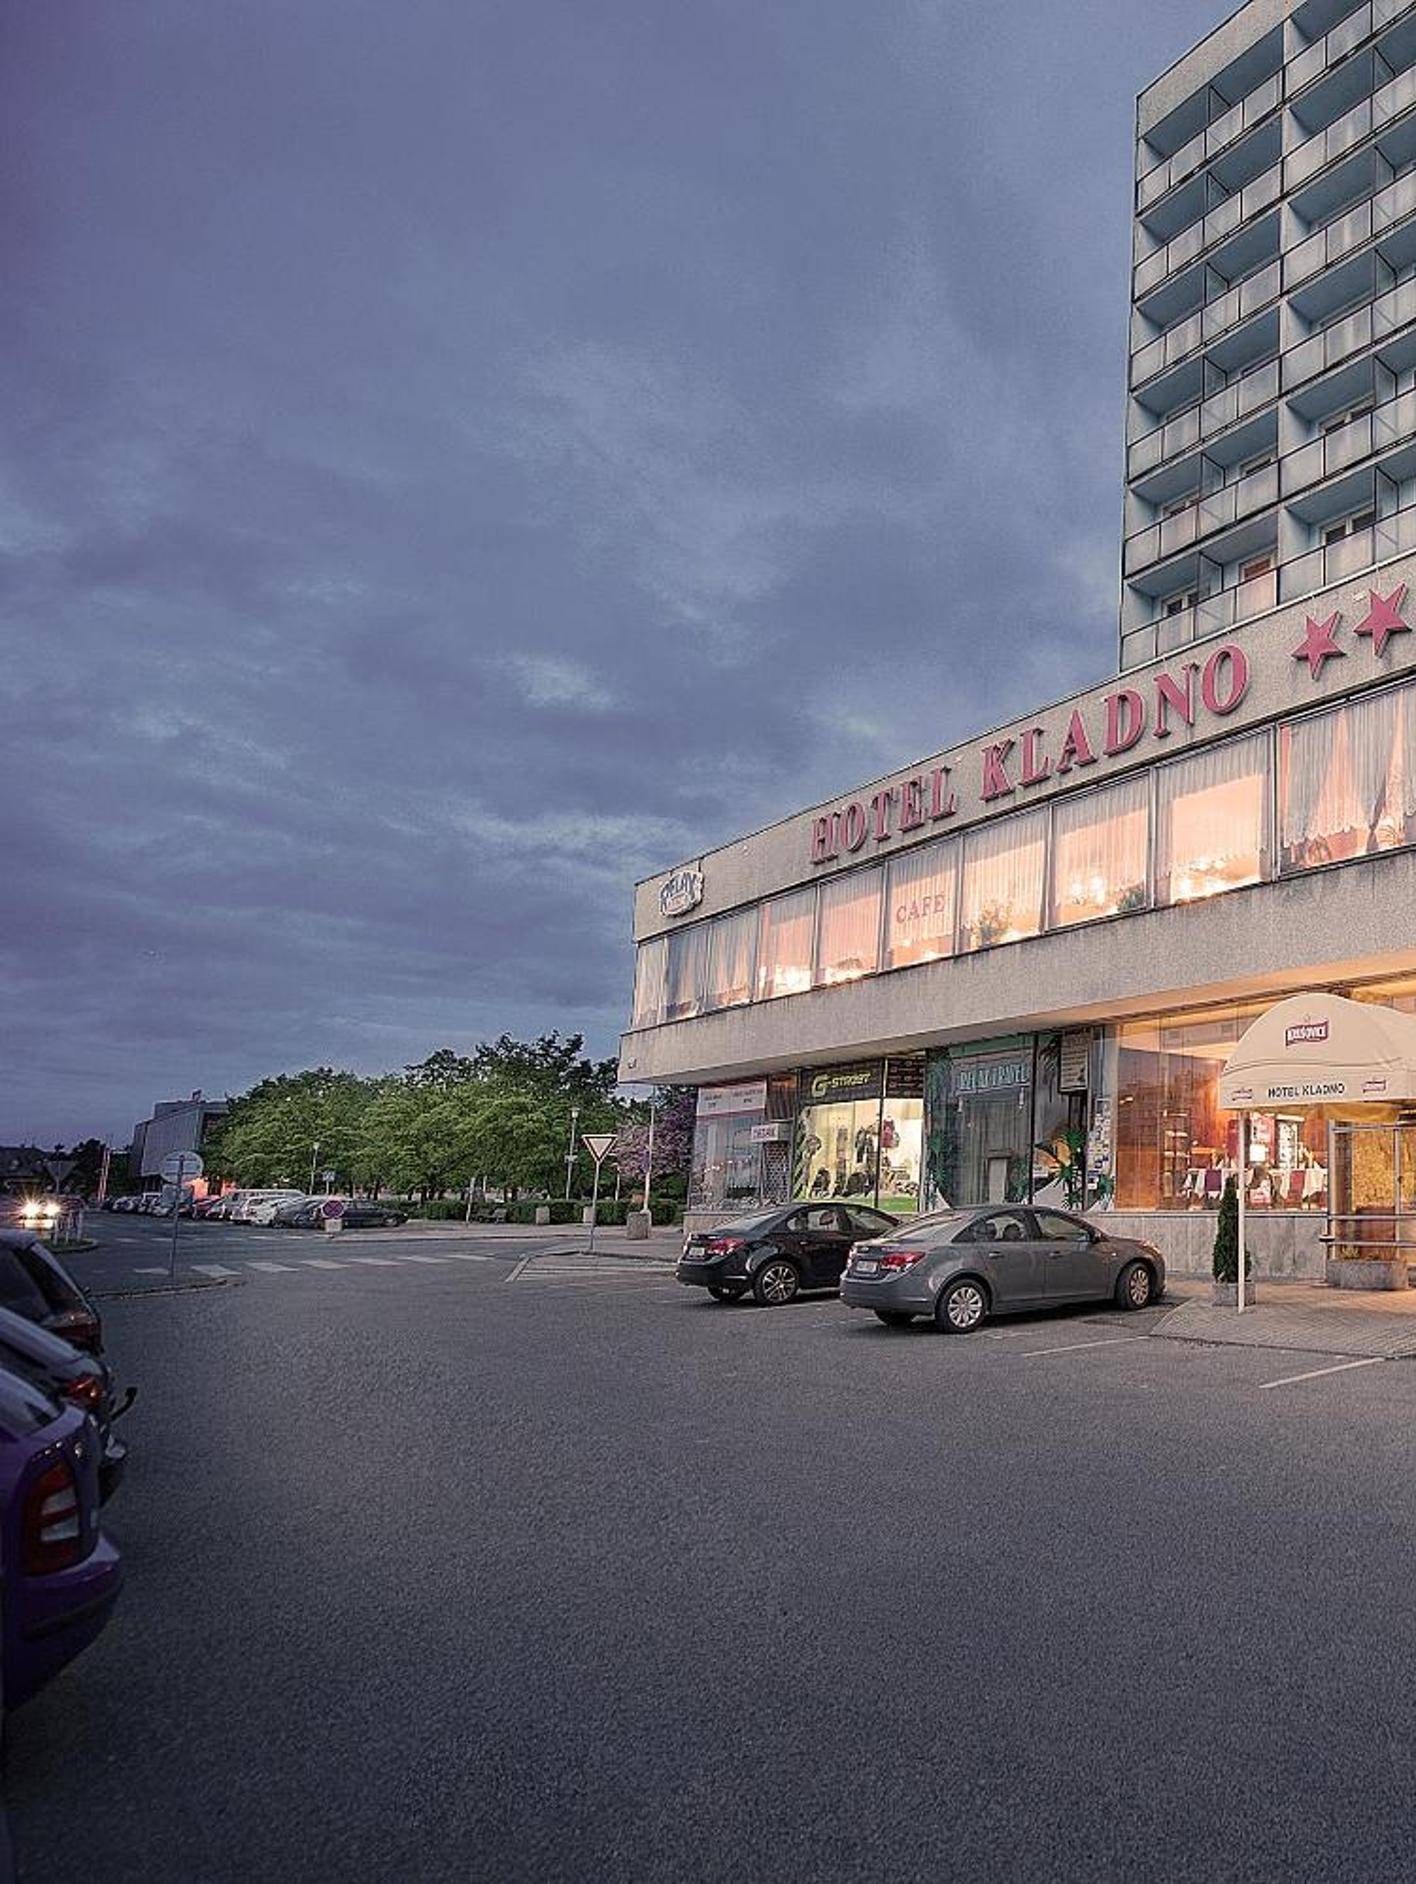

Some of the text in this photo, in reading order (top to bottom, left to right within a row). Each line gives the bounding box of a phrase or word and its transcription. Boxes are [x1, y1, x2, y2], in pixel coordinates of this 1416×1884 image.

[810, 643, 1250, 865] HOTEL KLADNO
[1267, 1086, 1299, 1099] HOTEL
[1302, 1082, 1345, 1097] KLADNO
